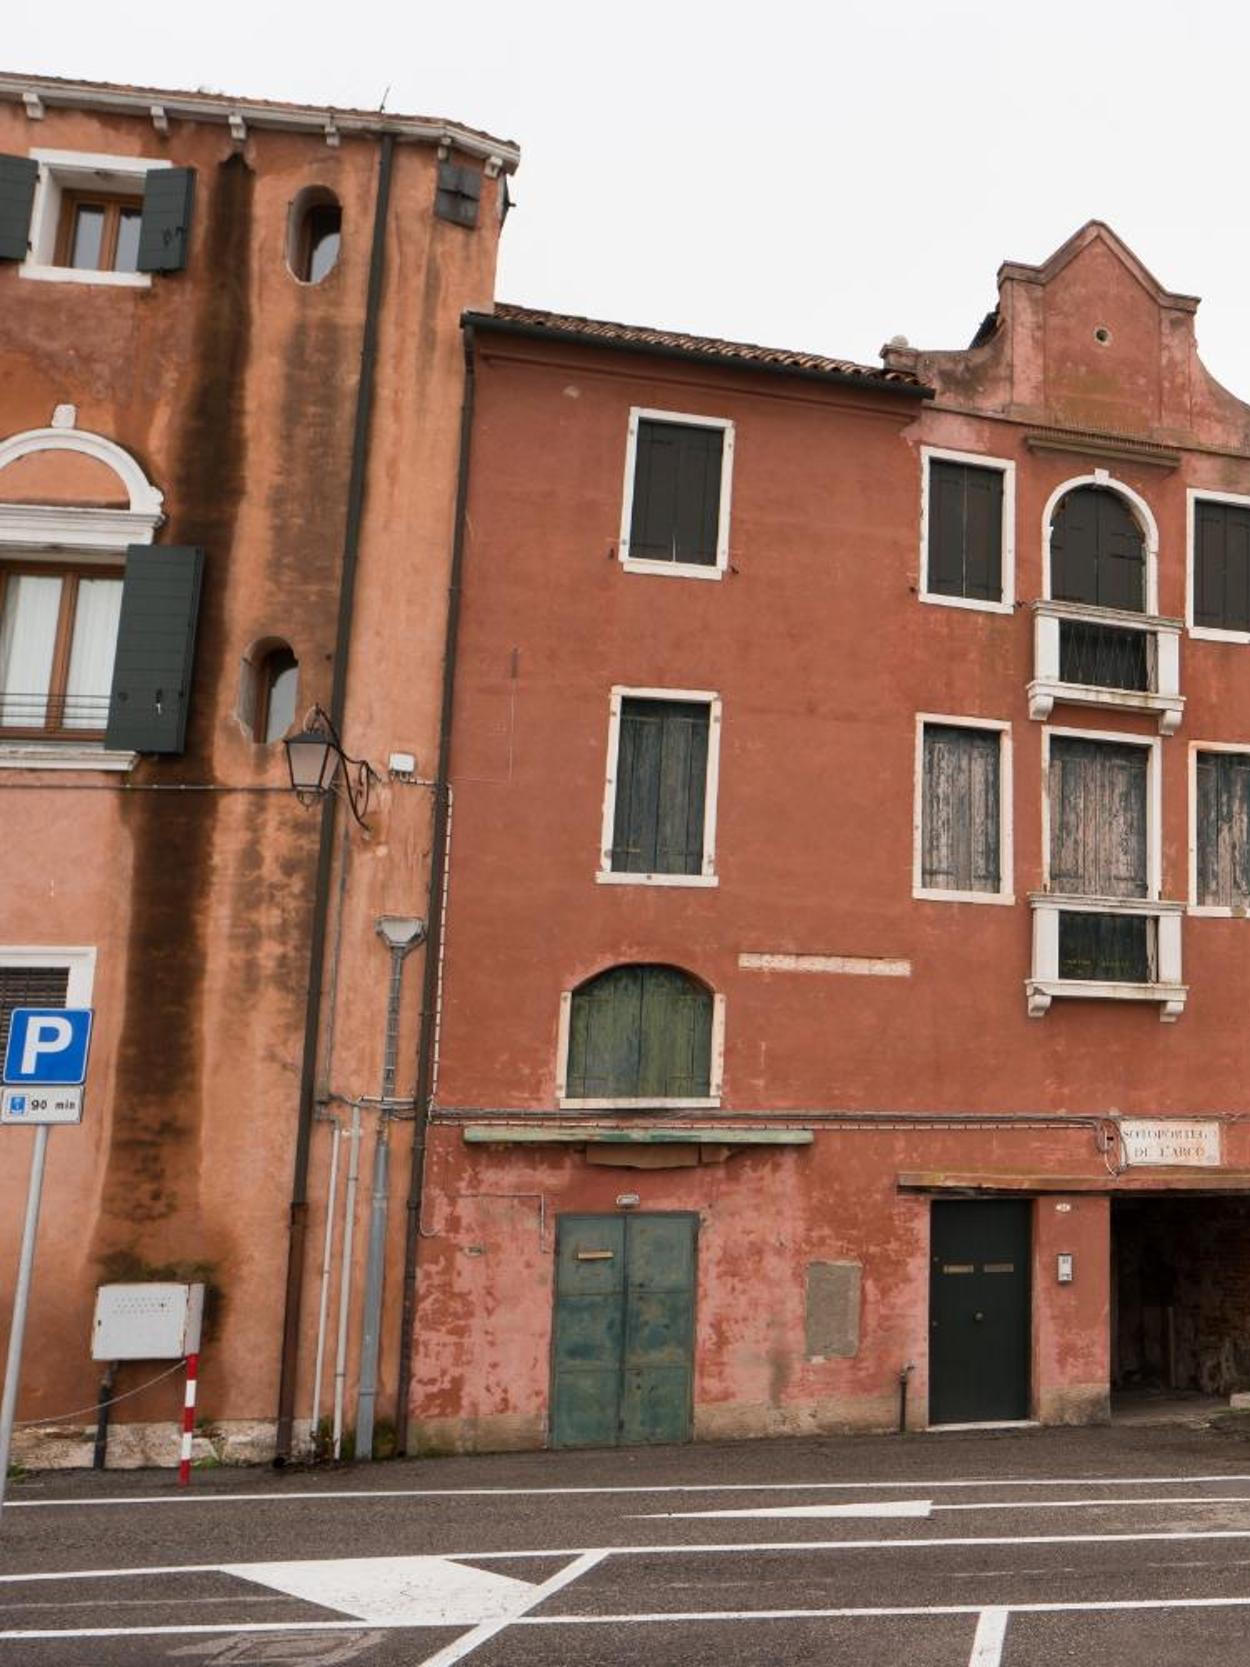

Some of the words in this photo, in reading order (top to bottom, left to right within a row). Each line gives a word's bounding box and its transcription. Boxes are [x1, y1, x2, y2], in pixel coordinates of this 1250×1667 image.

[20, 1016, 73, 1074] P
[31, 1099, 47, 1110] 90
[54, 1099, 76, 1110] min
